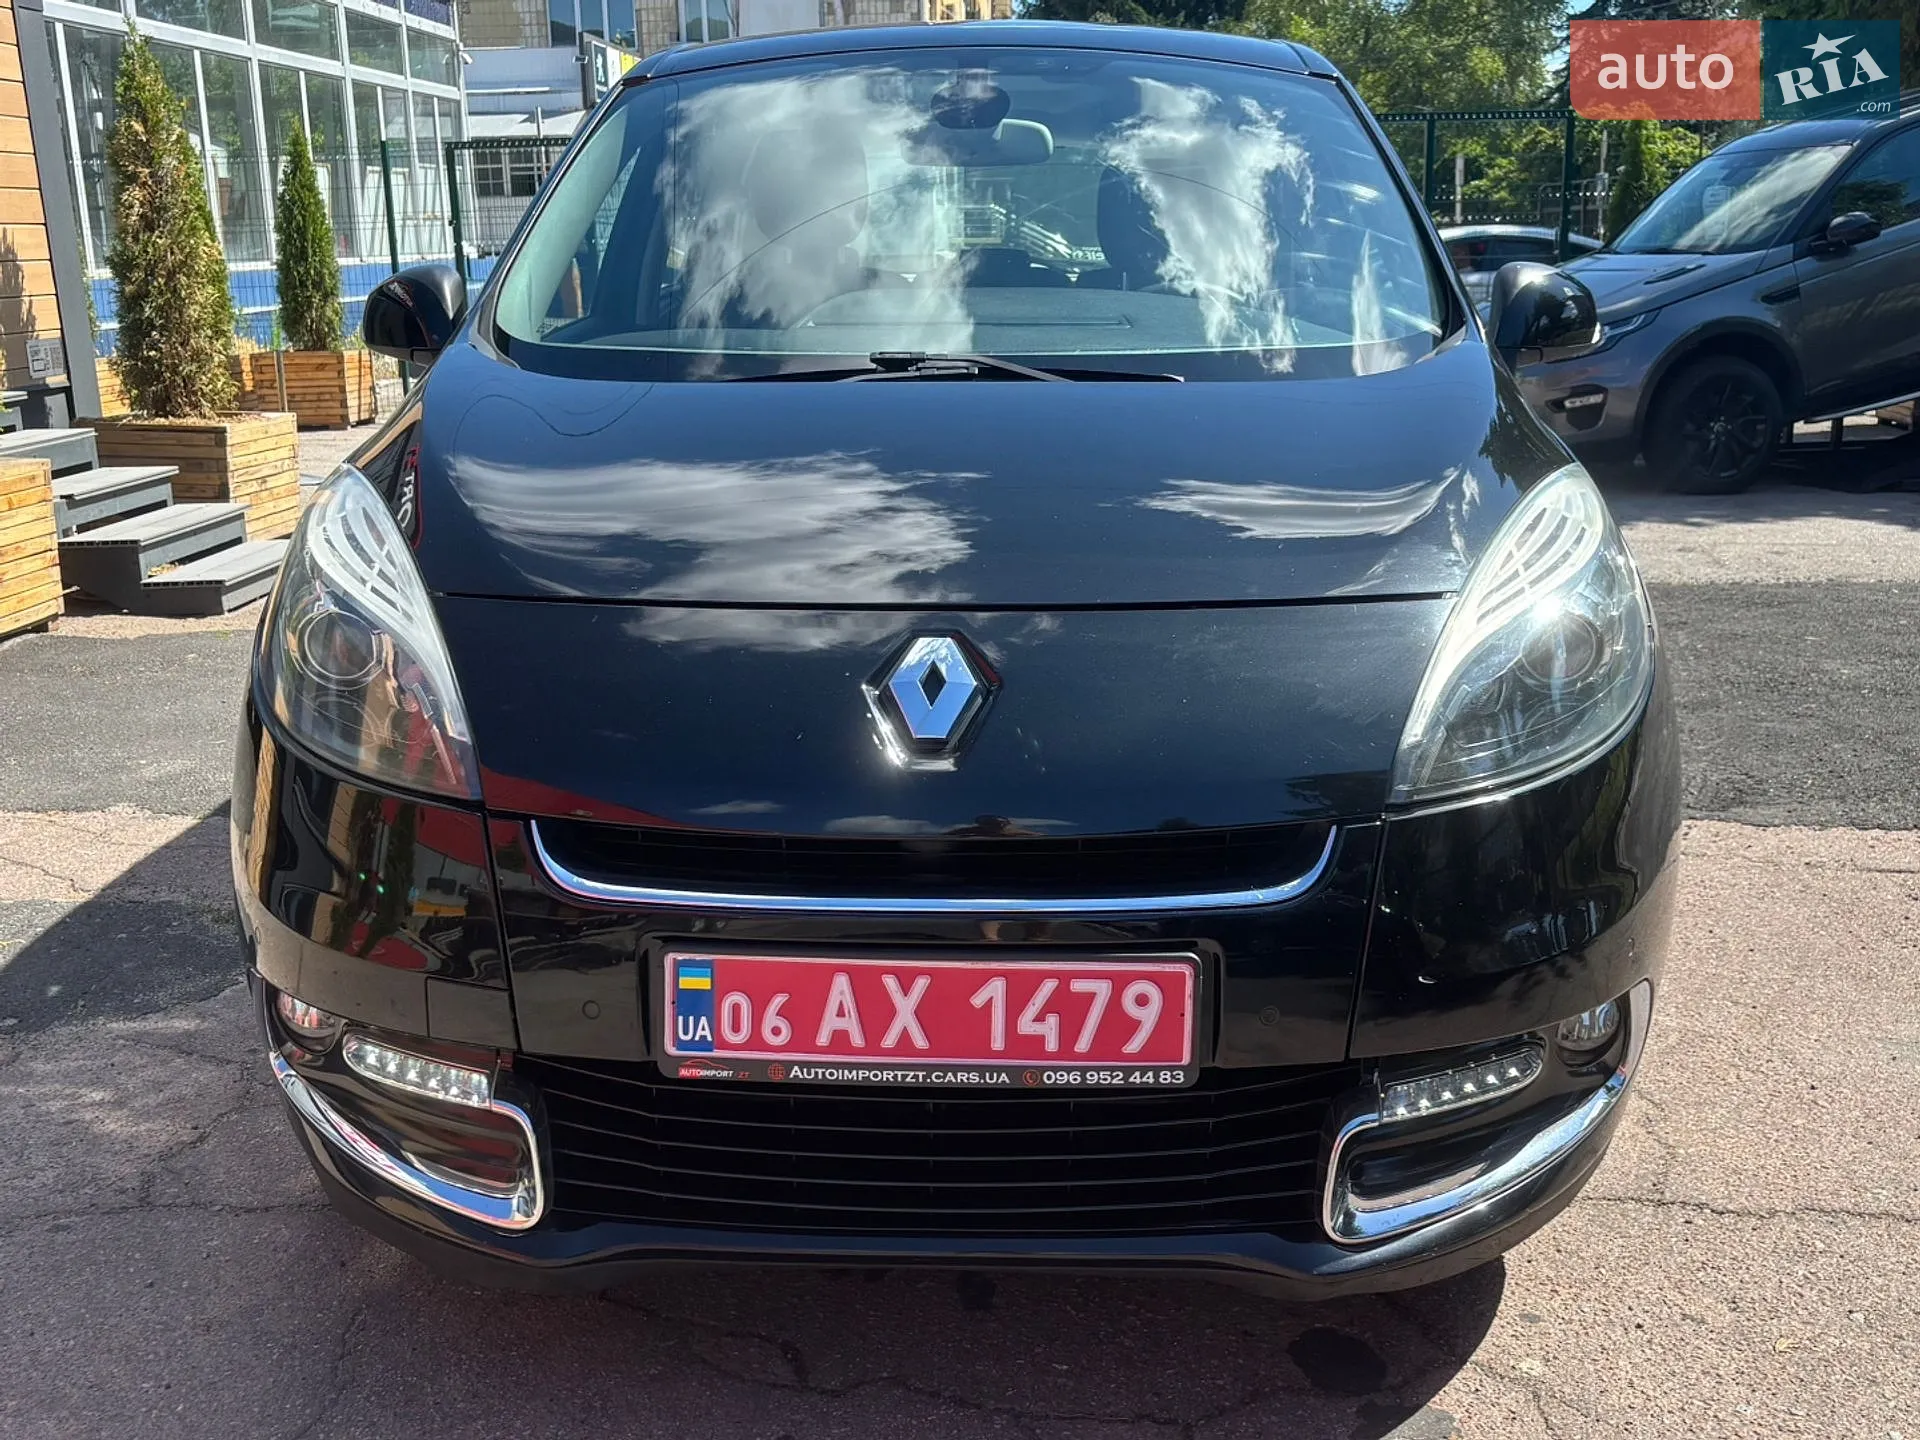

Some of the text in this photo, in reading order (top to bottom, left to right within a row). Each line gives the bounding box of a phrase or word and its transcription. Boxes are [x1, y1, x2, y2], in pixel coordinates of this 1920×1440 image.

[721, 972, 1163, 1053] 06 AX 1479
[677, 1016, 713, 1041] UA
[1043, 1070, 1185, 1084] 096 952 44 83
